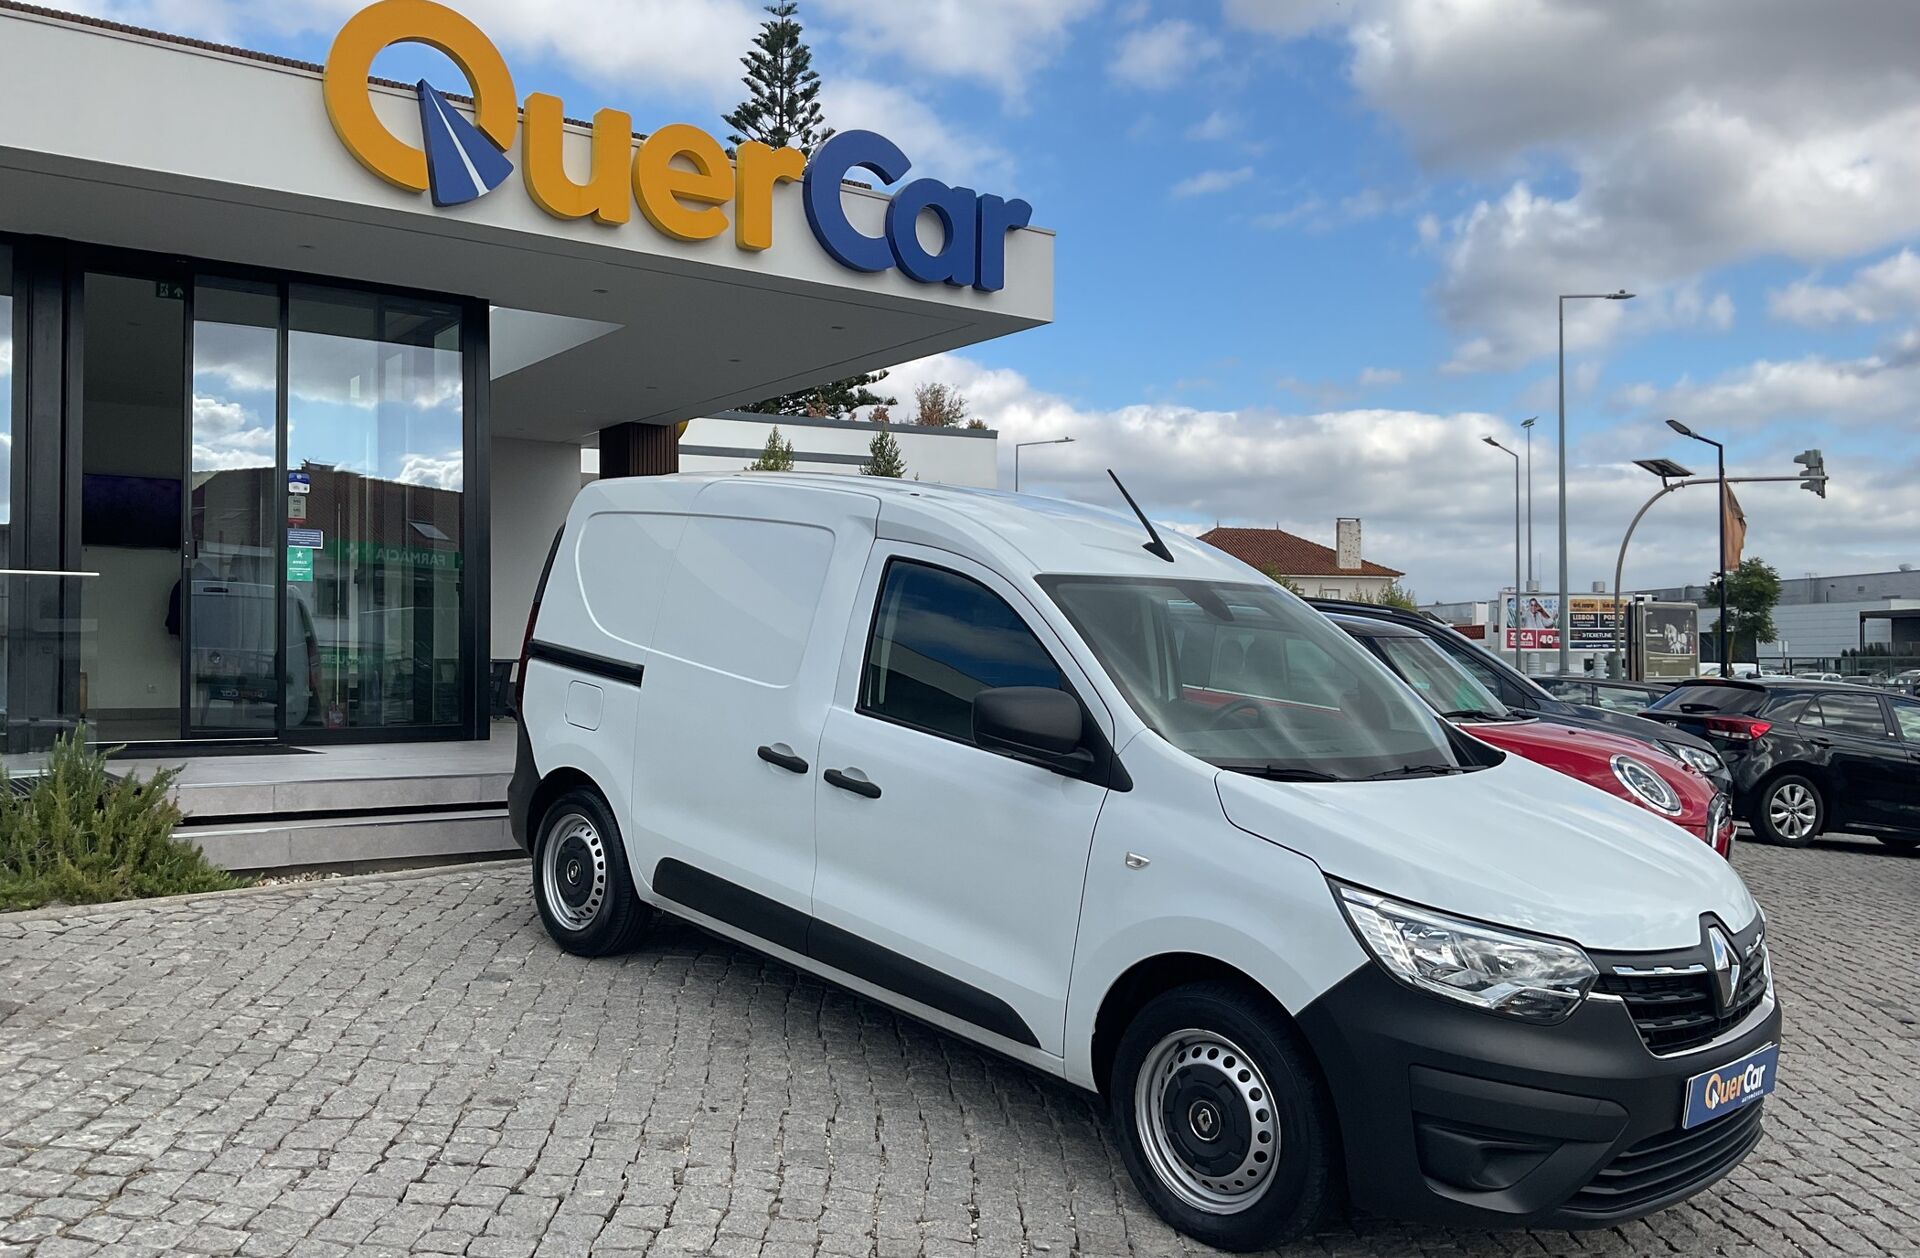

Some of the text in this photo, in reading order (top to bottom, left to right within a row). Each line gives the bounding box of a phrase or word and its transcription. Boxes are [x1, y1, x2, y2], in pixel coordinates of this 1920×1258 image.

[323, 0, 1033, 292] QuerCar
[1509, 632, 1534, 641] ZCA
[1540, 634, 1554, 644] 40
[1705, 1063, 1766, 1110] QuerCar
